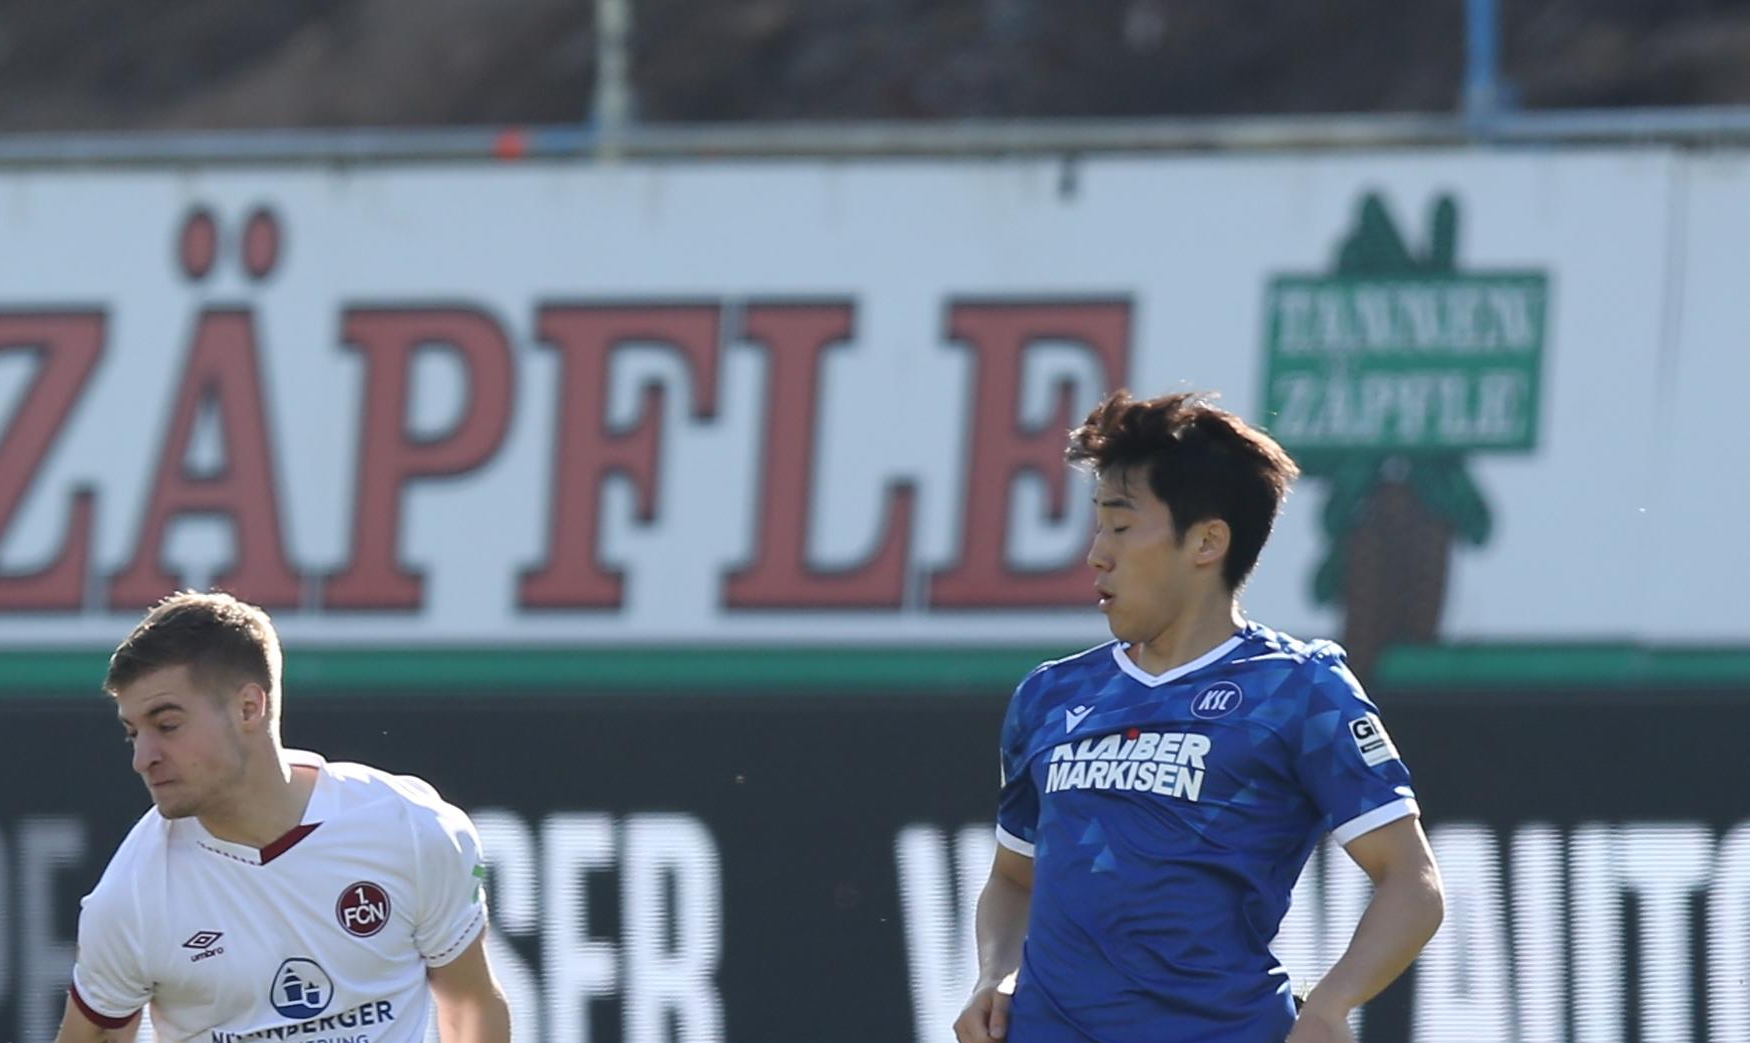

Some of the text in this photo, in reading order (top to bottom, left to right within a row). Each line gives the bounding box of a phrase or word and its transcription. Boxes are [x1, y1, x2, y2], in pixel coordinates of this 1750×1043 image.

[1278, 284, 1535, 351] TANNEN
[1270, 357, 1526, 441] ZÄPFLE
[1198, 688, 1236, 711] KSC
[1045, 760, 1204, 802] MARKISEN
[342, 902, 385, 928] FCN
[190, 946, 225, 963] umbro
